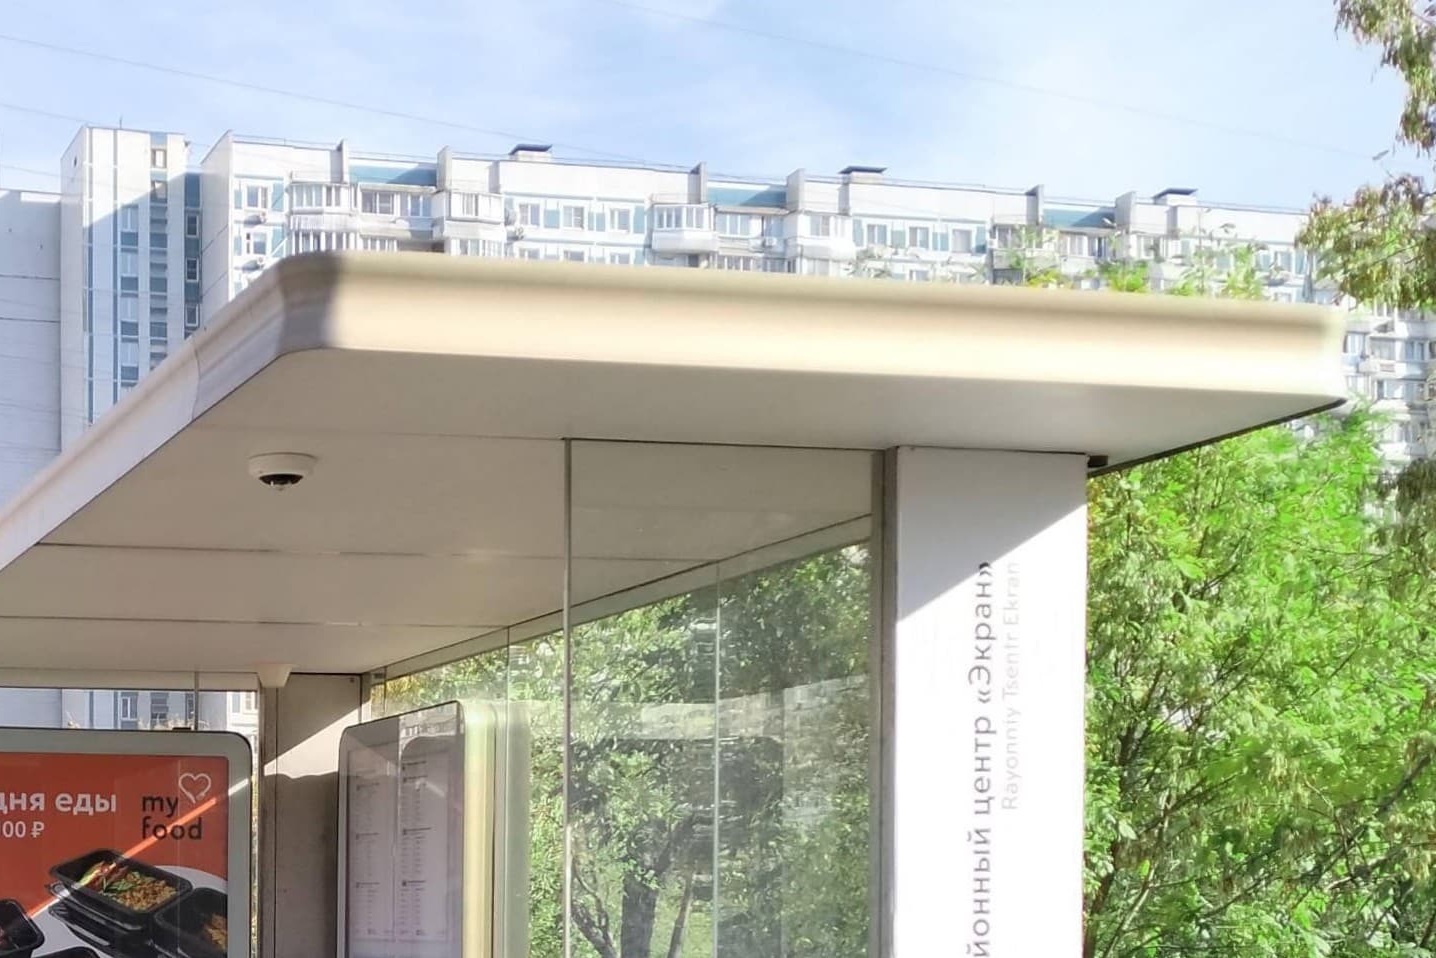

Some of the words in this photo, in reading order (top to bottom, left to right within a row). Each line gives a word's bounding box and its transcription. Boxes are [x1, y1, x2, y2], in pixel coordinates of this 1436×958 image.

[1001, 561, 1020, 626] Ekran
[967, 560, 996, 704] «Экран»
[1001, 632, 1020, 700] Tsentr
[970, 715, 996, 816] центр
[1000, 706, 1022, 811] Rayonniy
[55, 792, 117, 816] еды
[141, 816, 203, 841] food
[142, 795, 179, 817] my
